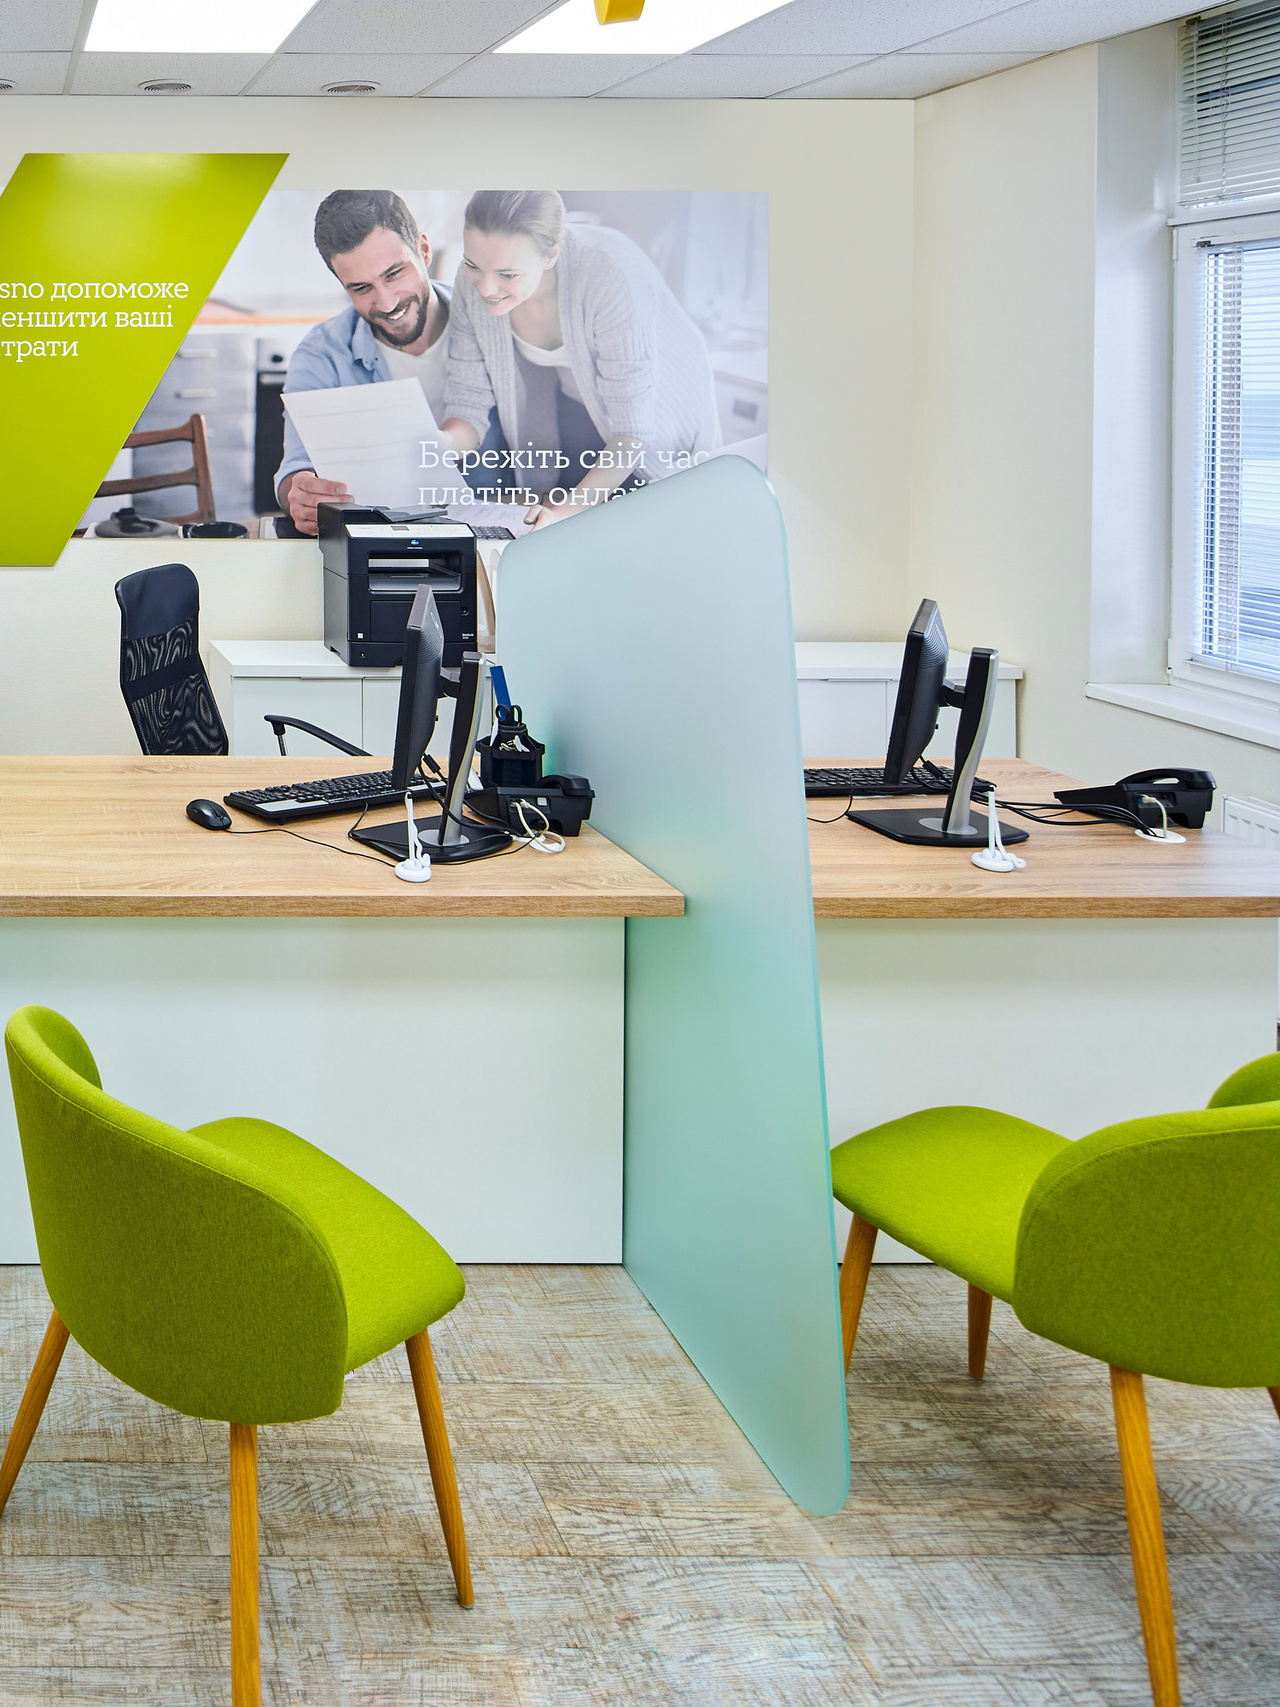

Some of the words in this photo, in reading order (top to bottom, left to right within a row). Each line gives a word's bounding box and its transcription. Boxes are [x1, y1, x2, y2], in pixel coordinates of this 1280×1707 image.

[50, 281, 190, 302] допоможе
[114, 304, 174, 328] ваші
[418, 440, 570, 475] Бережіть
[578, 441, 647, 469] свій
[656, 450, 710, 469] час
[418, 478, 540, 506] платіть
